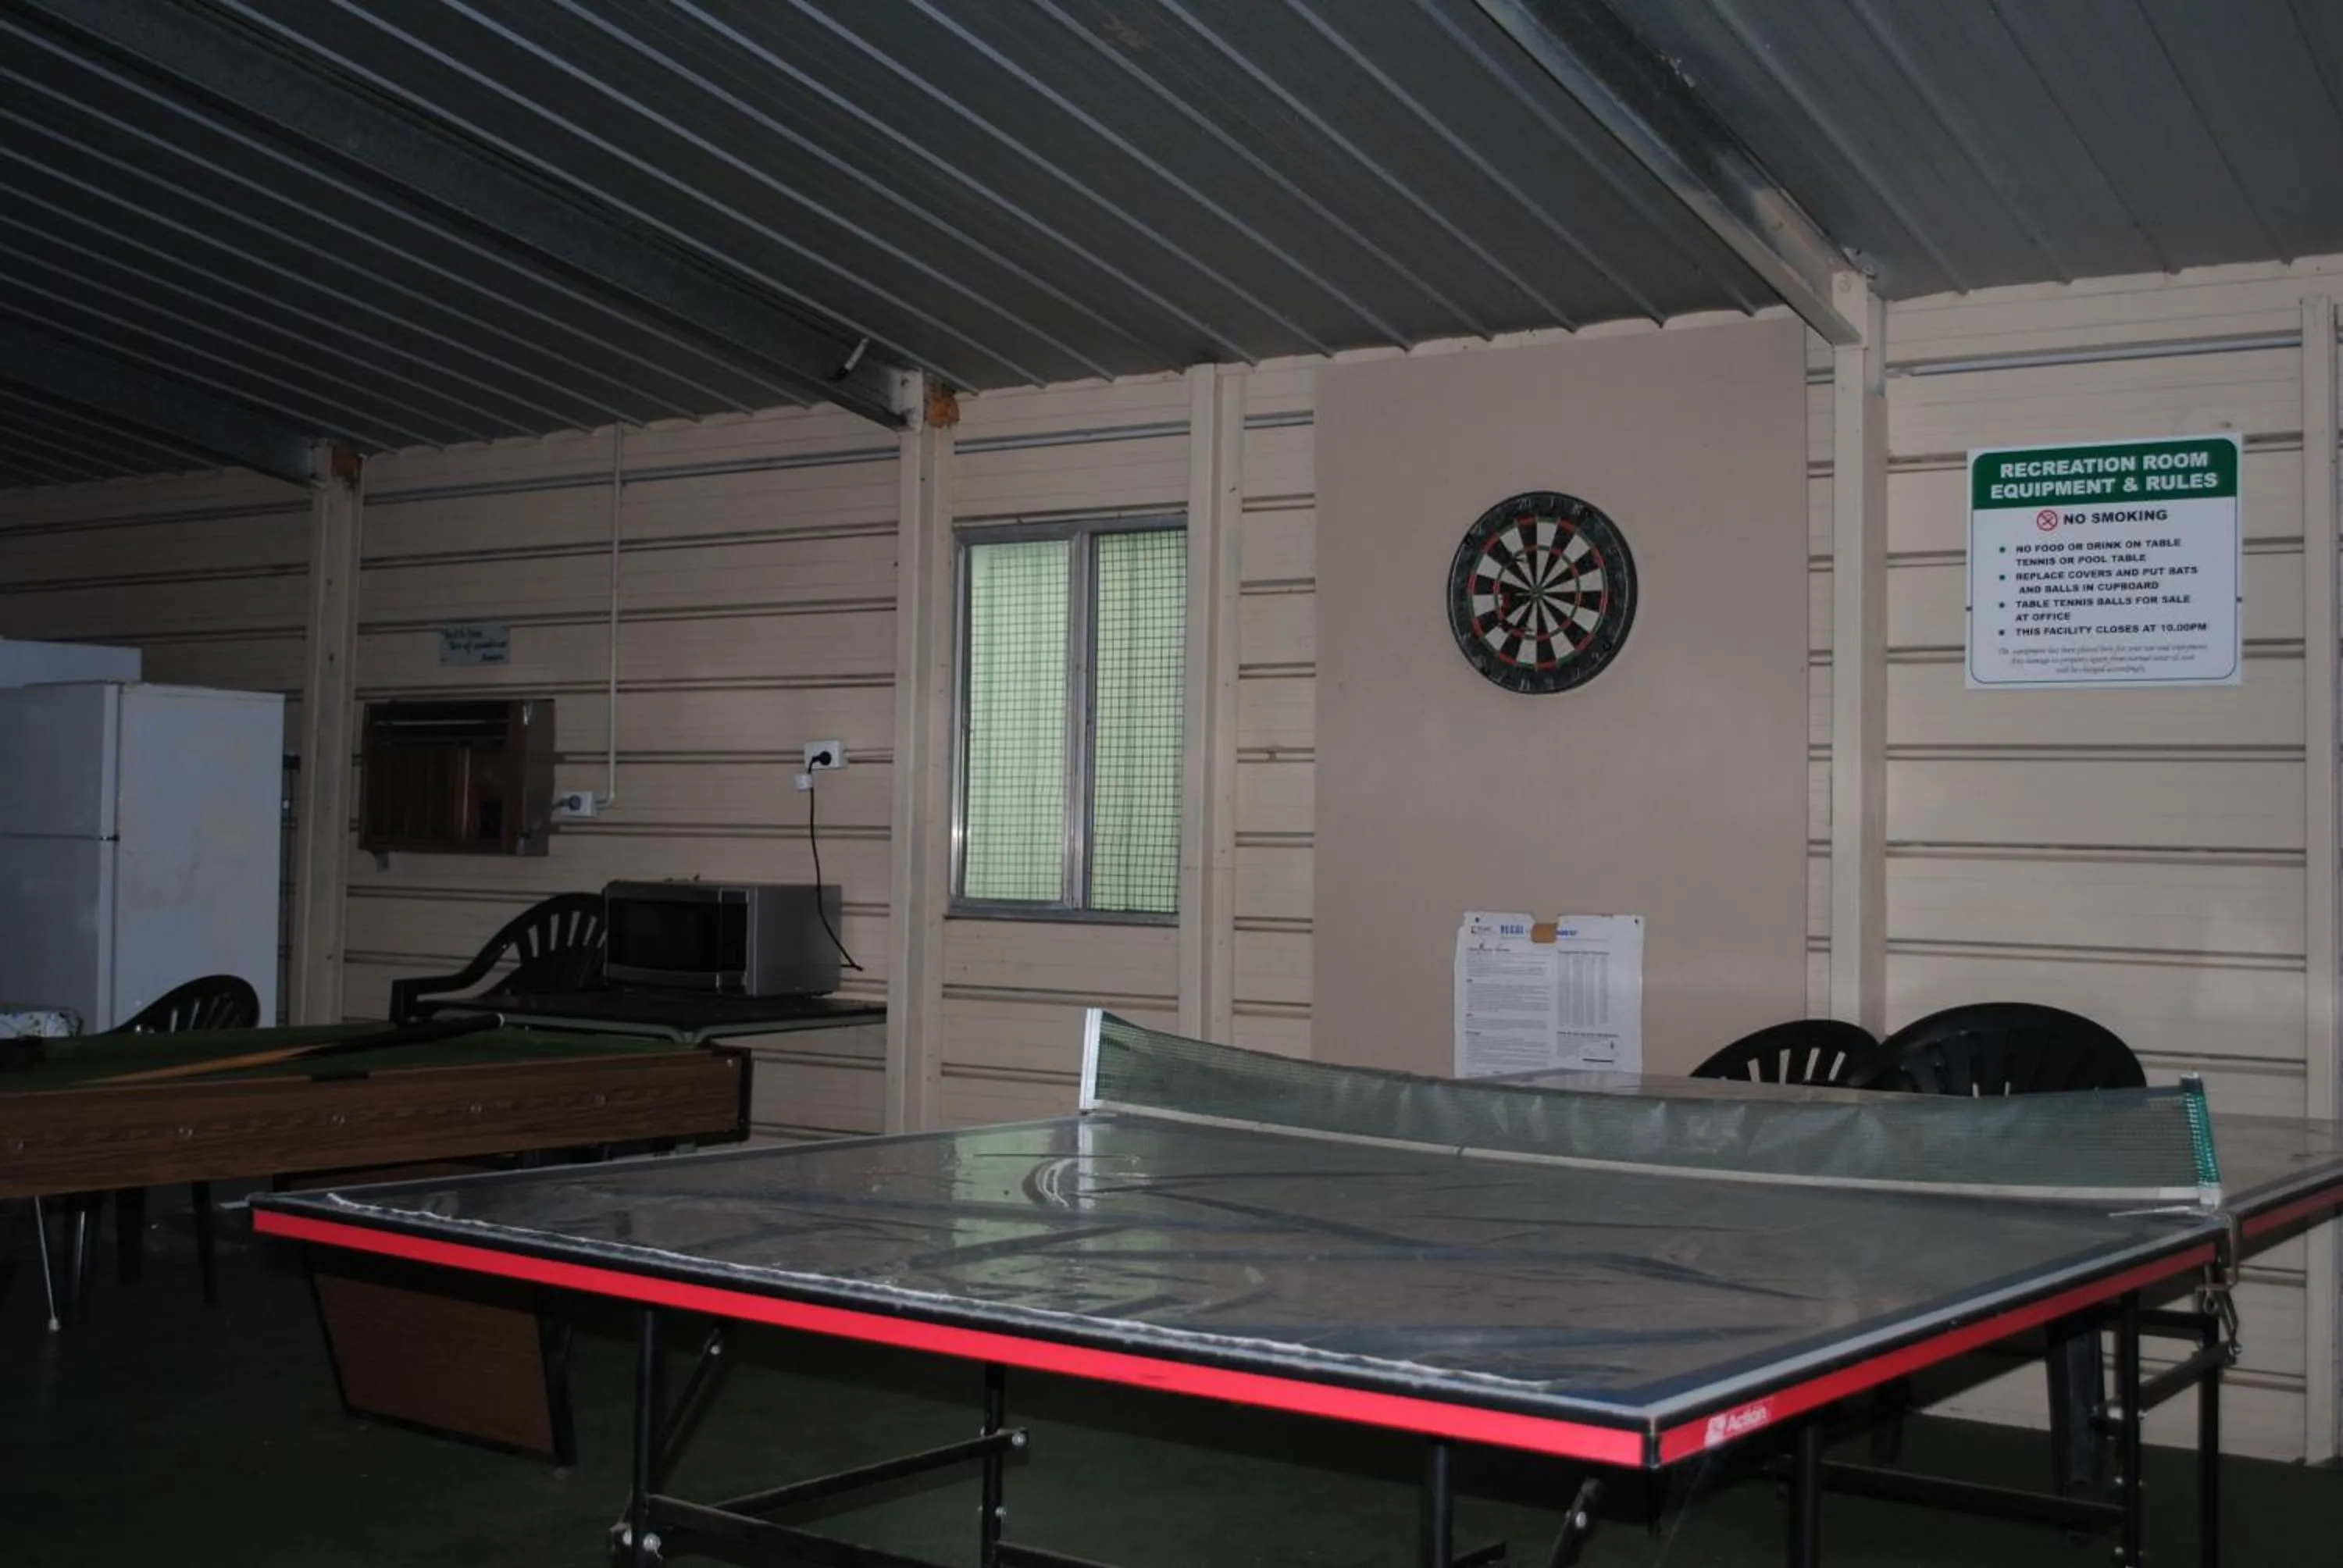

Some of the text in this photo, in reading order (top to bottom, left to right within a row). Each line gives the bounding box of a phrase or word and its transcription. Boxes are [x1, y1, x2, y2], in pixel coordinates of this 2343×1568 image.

[2000, 452, 2209, 479] RECREATION ROOM
[1990, 472, 2218, 499] EQUIPMENT & RULES
[2063, 510, 2168, 525] NO SMOKING
[2016, 538, 2181, 554] NO FOOD OR DRINK ON TABLE
[2016, 553, 2146, 566] TENNIS OR POOL TABLE
[2016, 565, 2199, 581] REPLACE COVERS AND PUT BATS
[2019, 581, 2159, 593] AND BALLS IN CUPBOARD
[2016, 595, 2191, 608] TABLE TENNIS BALLS FOR SALE
[2015, 612, 2071, 622] AT OFFICE
[2016, 622, 2207, 636] THIS FACILITY CLOSES AT 10.00PM
